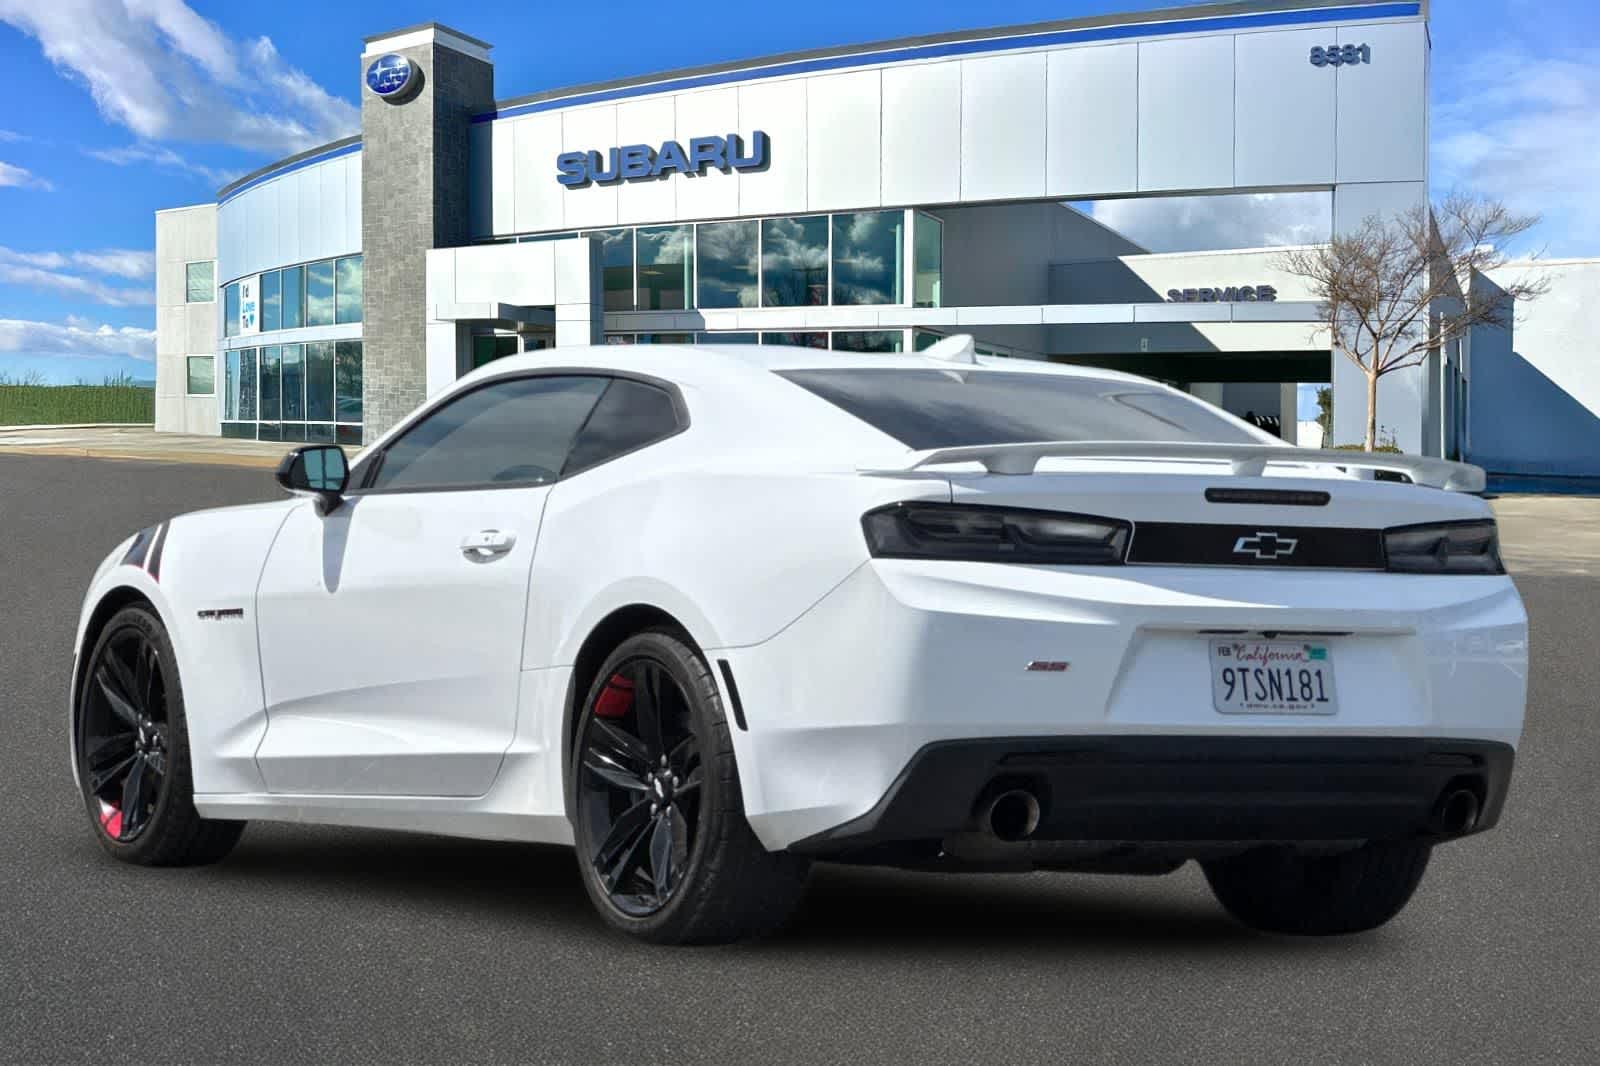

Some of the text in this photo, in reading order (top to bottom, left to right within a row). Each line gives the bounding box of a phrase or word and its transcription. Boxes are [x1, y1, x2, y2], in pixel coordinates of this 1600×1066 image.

[556, 130, 771, 190] SUBARU
[1167, 285, 1277, 303] SERVICE
[1235, 645, 1311, 666] California
[1222, 667, 1329, 702] 9TSN181
